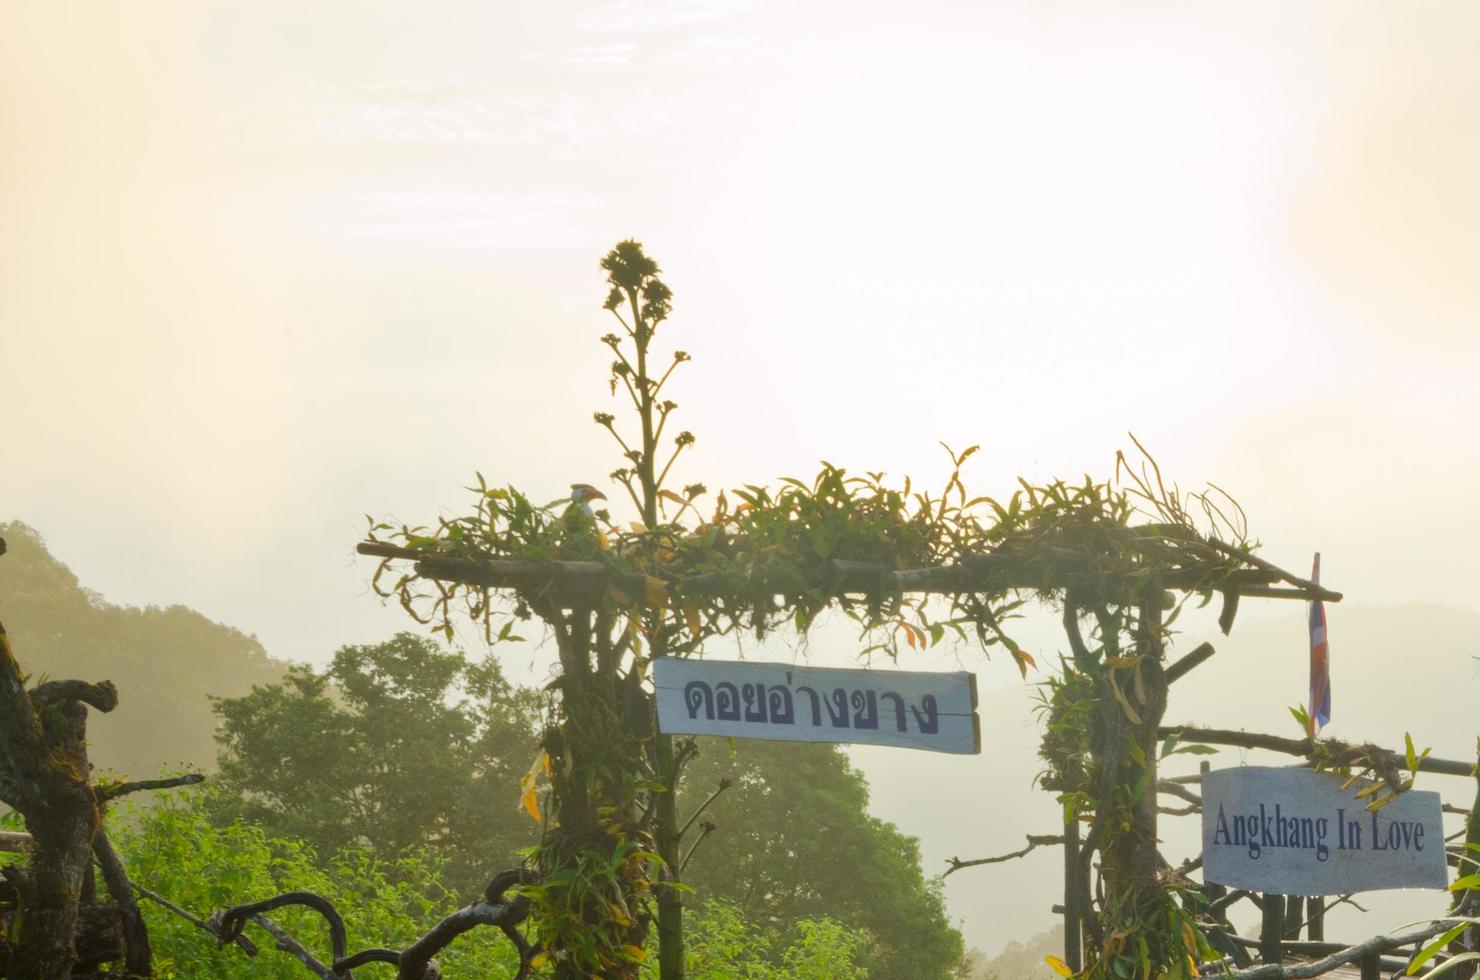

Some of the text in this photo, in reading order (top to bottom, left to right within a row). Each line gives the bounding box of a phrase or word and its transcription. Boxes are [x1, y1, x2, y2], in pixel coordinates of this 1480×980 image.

[684, 671, 938, 734] ดอยอ่างขาง
[1213, 801, 1425, 862] Angkhang In Love
